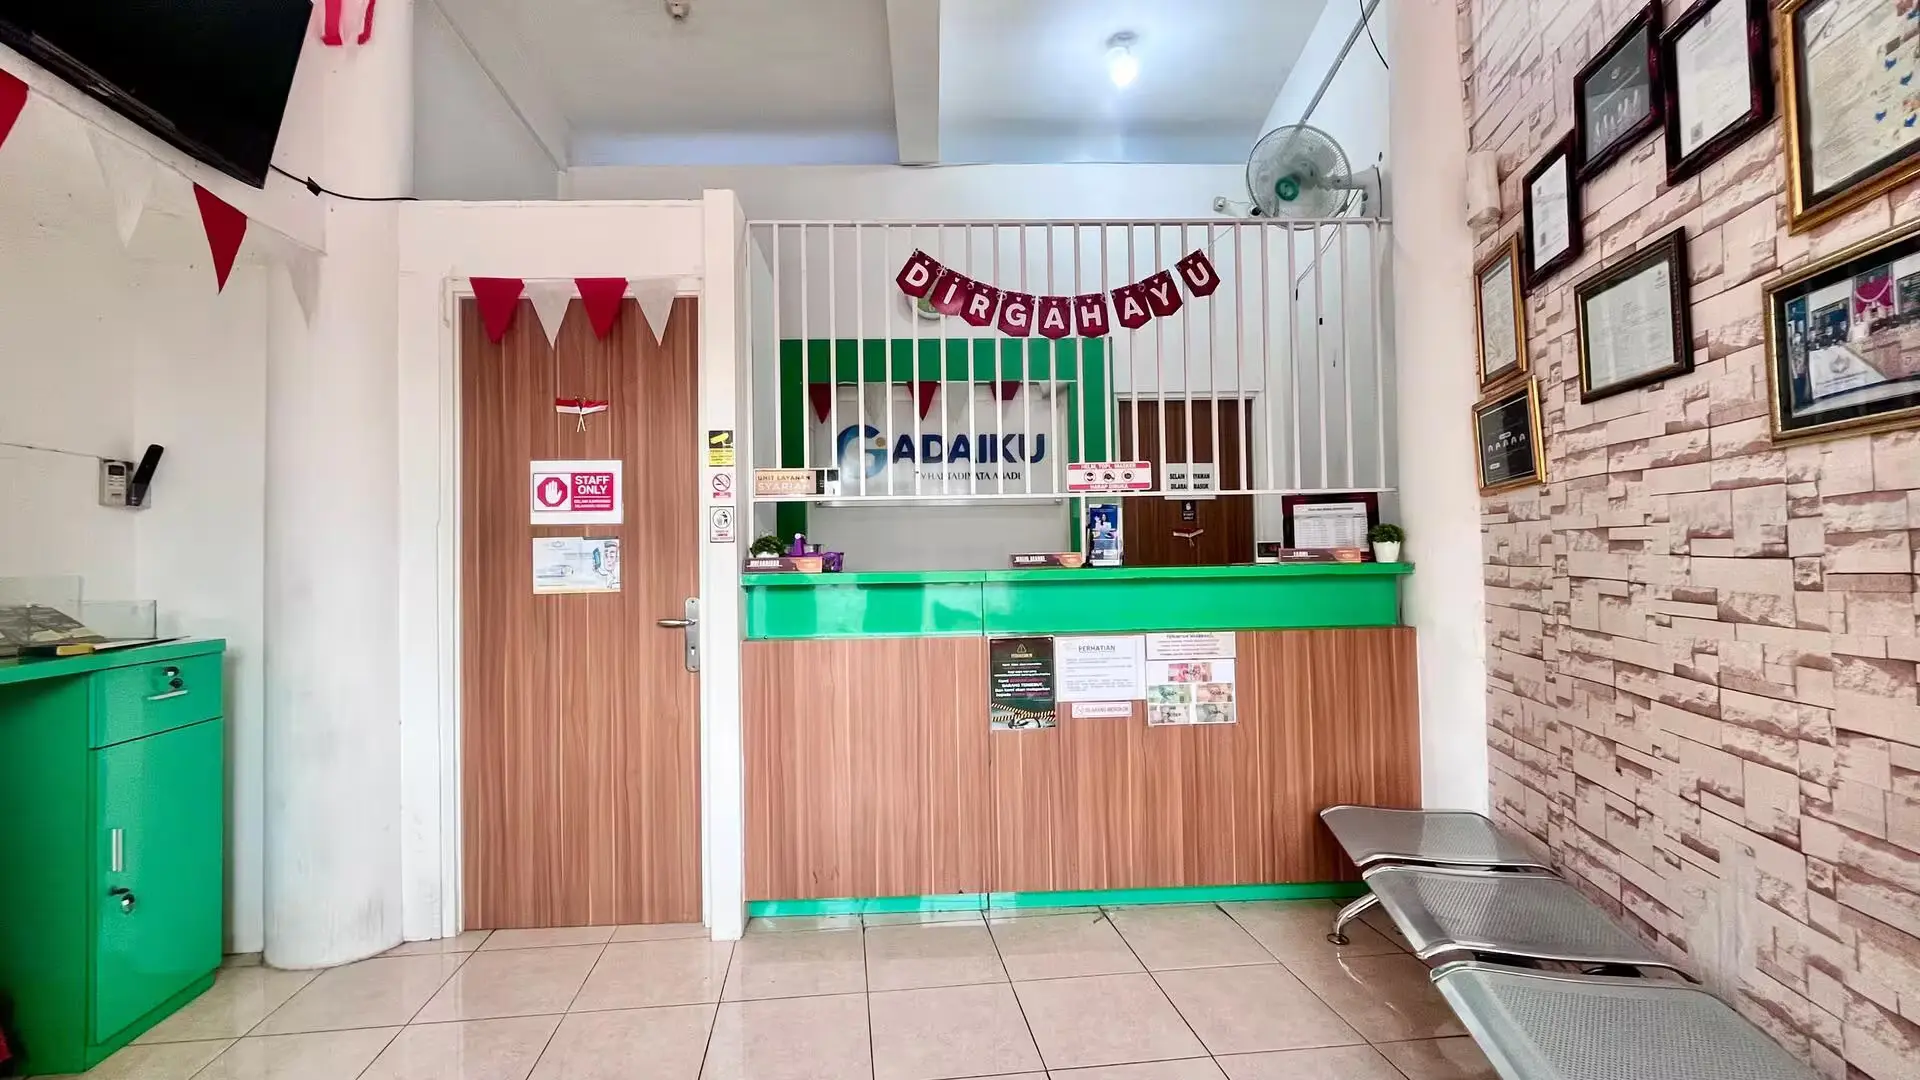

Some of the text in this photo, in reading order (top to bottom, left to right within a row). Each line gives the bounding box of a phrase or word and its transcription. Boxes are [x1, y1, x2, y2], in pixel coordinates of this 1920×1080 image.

[904, 261, 1209, 332] DIRGAHAYU
[575, 475, 610, 485] STAFF
[993, 472, 1022, 480] AADI
[578, 485, 608, 495] ONLY
[757, 482, 810, 491] SYARIAH
[1078, 644, 1116, 652] PERHATIAN
